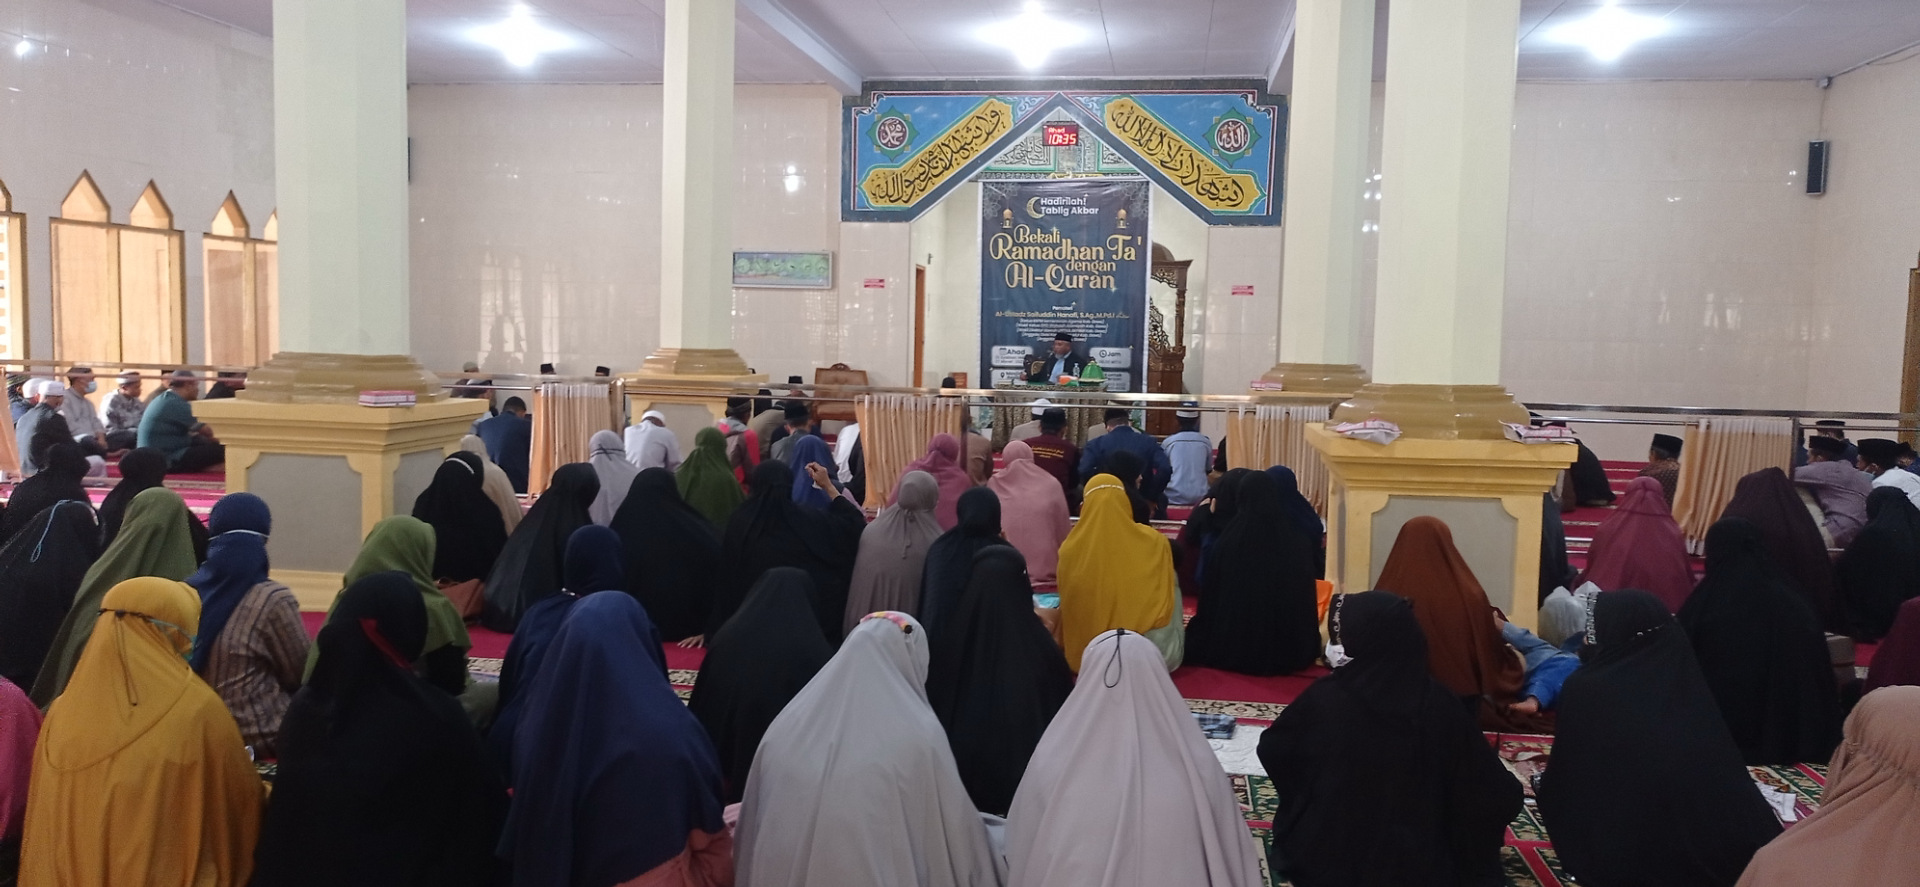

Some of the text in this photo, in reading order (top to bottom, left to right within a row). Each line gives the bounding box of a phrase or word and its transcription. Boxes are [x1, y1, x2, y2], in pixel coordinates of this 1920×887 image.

[1048, 133, 1077, 145] 10:35
[1040, 196, 1087, 206] Hadirilah!
[1041, 206, 1099, 216] Tablig Akbar
[1014, 224, 1061, 244] Bekali
[990, 232, 1142, 261] Ramadhan Ta'
[1066, 257, 1115, 274] dengan
[1005, 261, 1115, 292] Al-Quran
